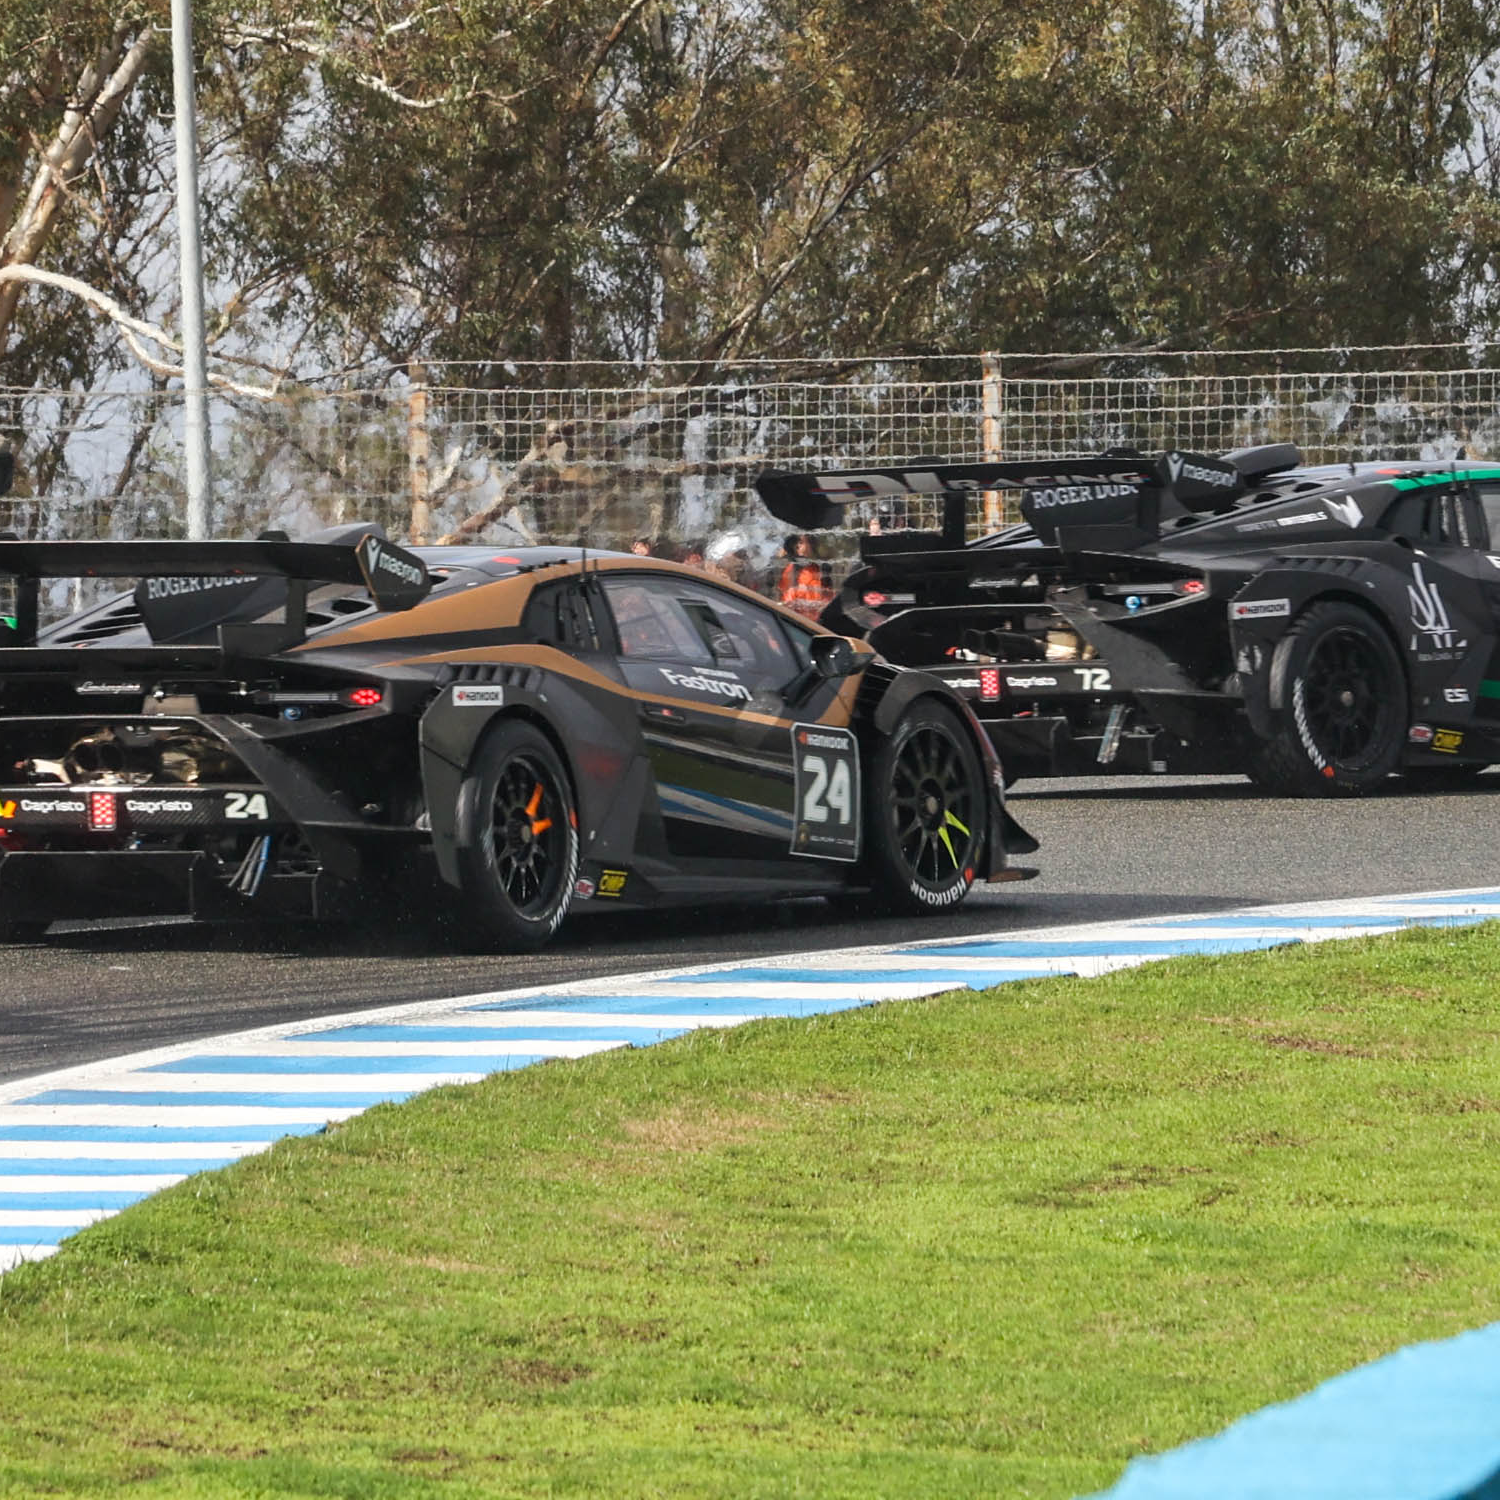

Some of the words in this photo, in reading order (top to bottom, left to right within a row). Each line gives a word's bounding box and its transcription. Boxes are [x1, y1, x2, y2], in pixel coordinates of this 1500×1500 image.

[1183, 464, 1236, 488] macron
[1034, 486, 1091, 510] ROGER
[379, 552, 423, 586] macron
[147, 577, 202, 600] ROGER
[659, 667, 754, 702] Fastron
[1073, 667, 1112, 691] 72
[803, 754, 851, 825] 24
[20, 799, 85, 814] Capristo
[126, 799, 193, 814] Capristo
[224, 792, 268, 820] 24
